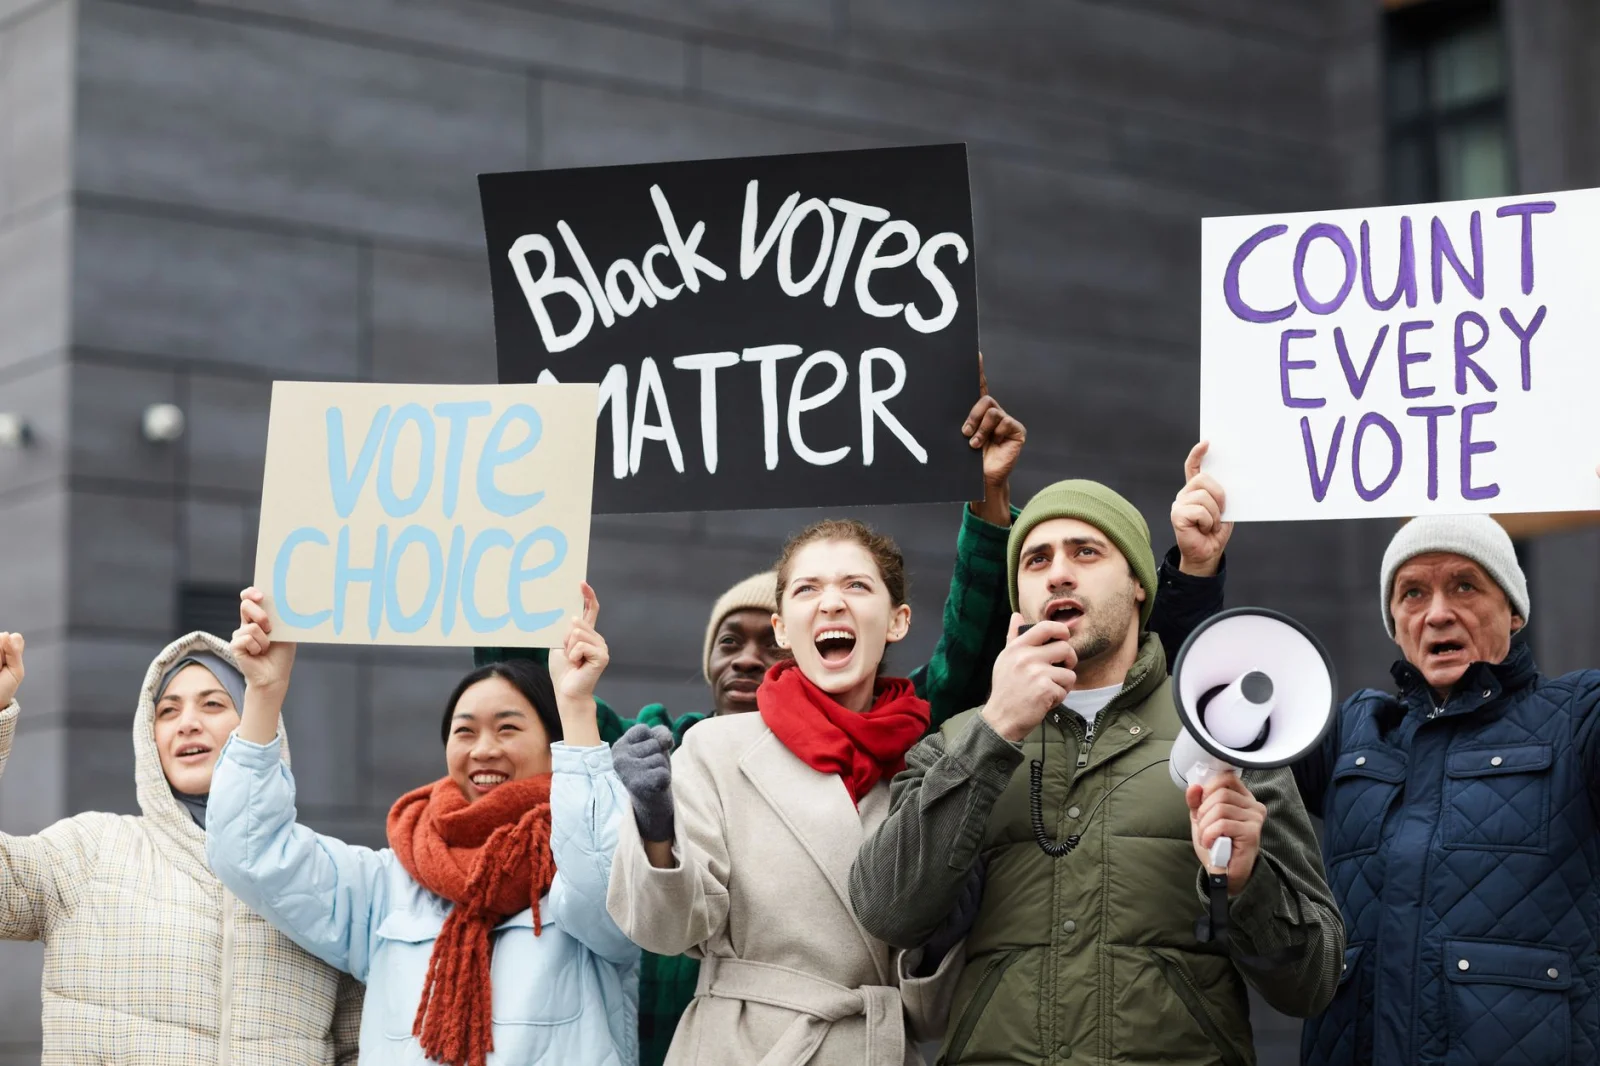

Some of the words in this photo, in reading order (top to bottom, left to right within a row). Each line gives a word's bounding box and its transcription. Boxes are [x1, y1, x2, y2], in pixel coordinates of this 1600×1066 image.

[508, 183, 727, 353] Black
[1223, 200, 1556, 324] COUNT
[1279, 305, 1547, 408] EVERY
[1300, 401, 1500, 502] VOTE
